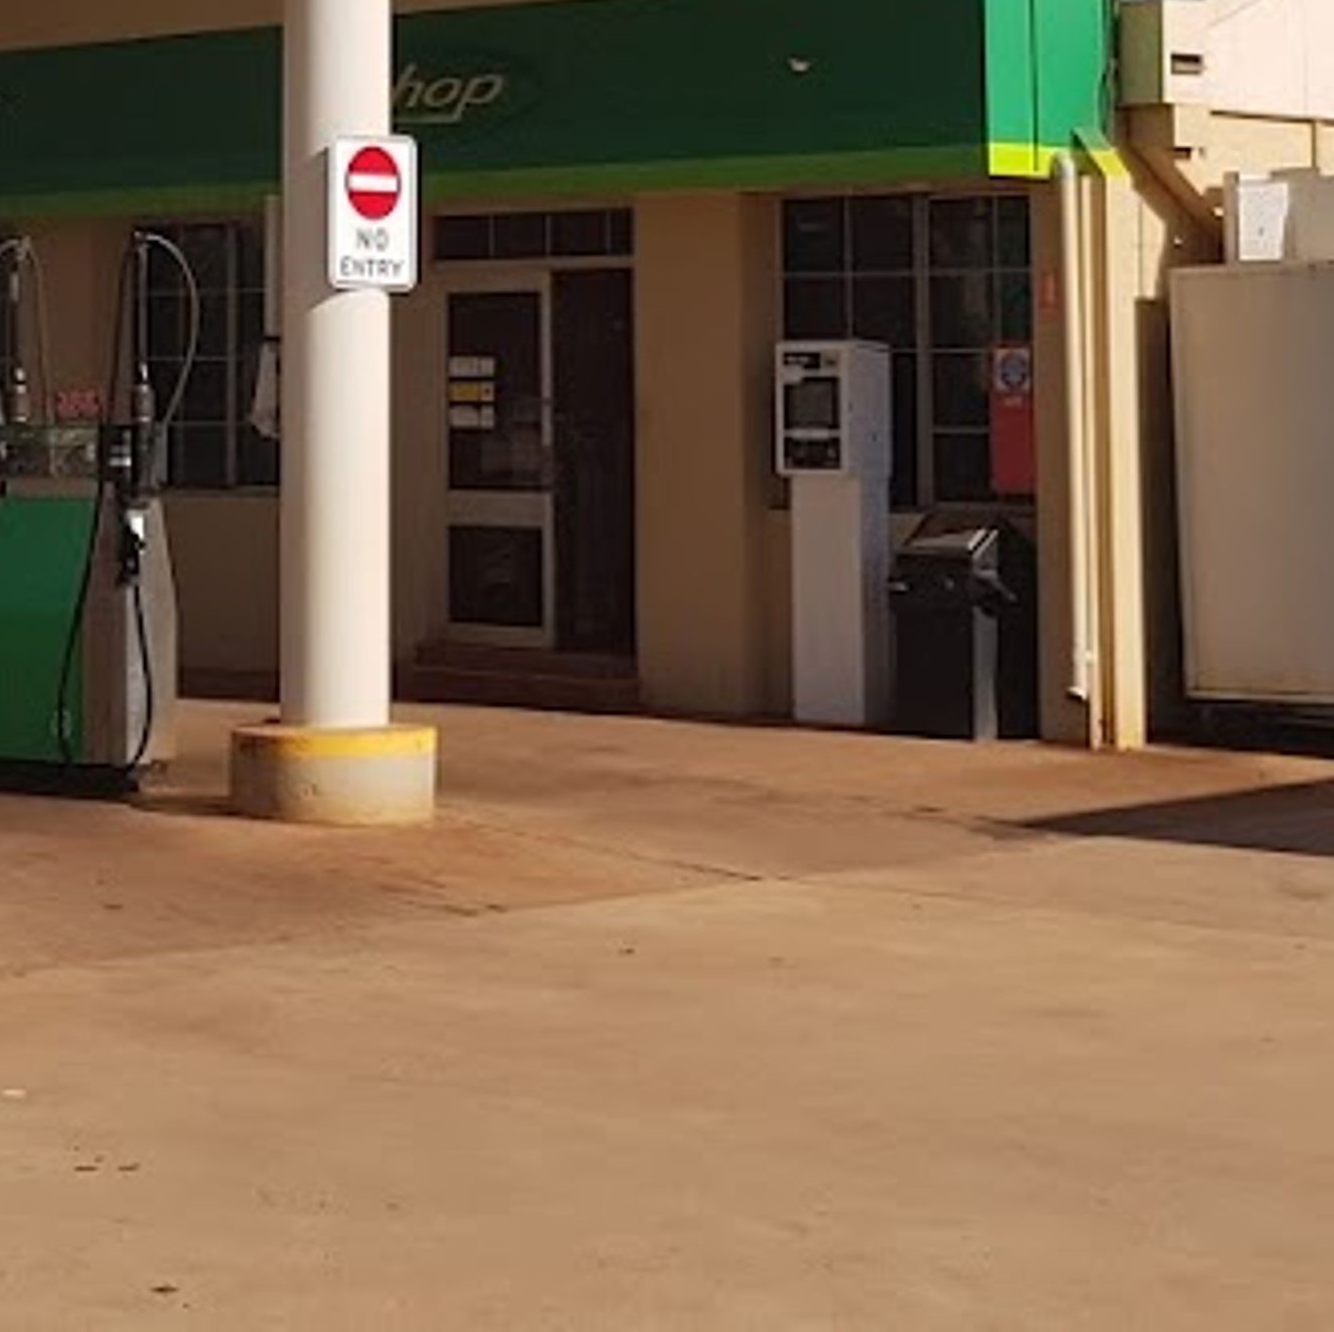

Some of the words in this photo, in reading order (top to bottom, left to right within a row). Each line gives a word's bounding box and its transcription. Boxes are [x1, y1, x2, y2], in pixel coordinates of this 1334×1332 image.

[392, 64, 505, 122] hop
[356, 228, 390, 252] NO
[340, 255, 405, 278] ENTRY
